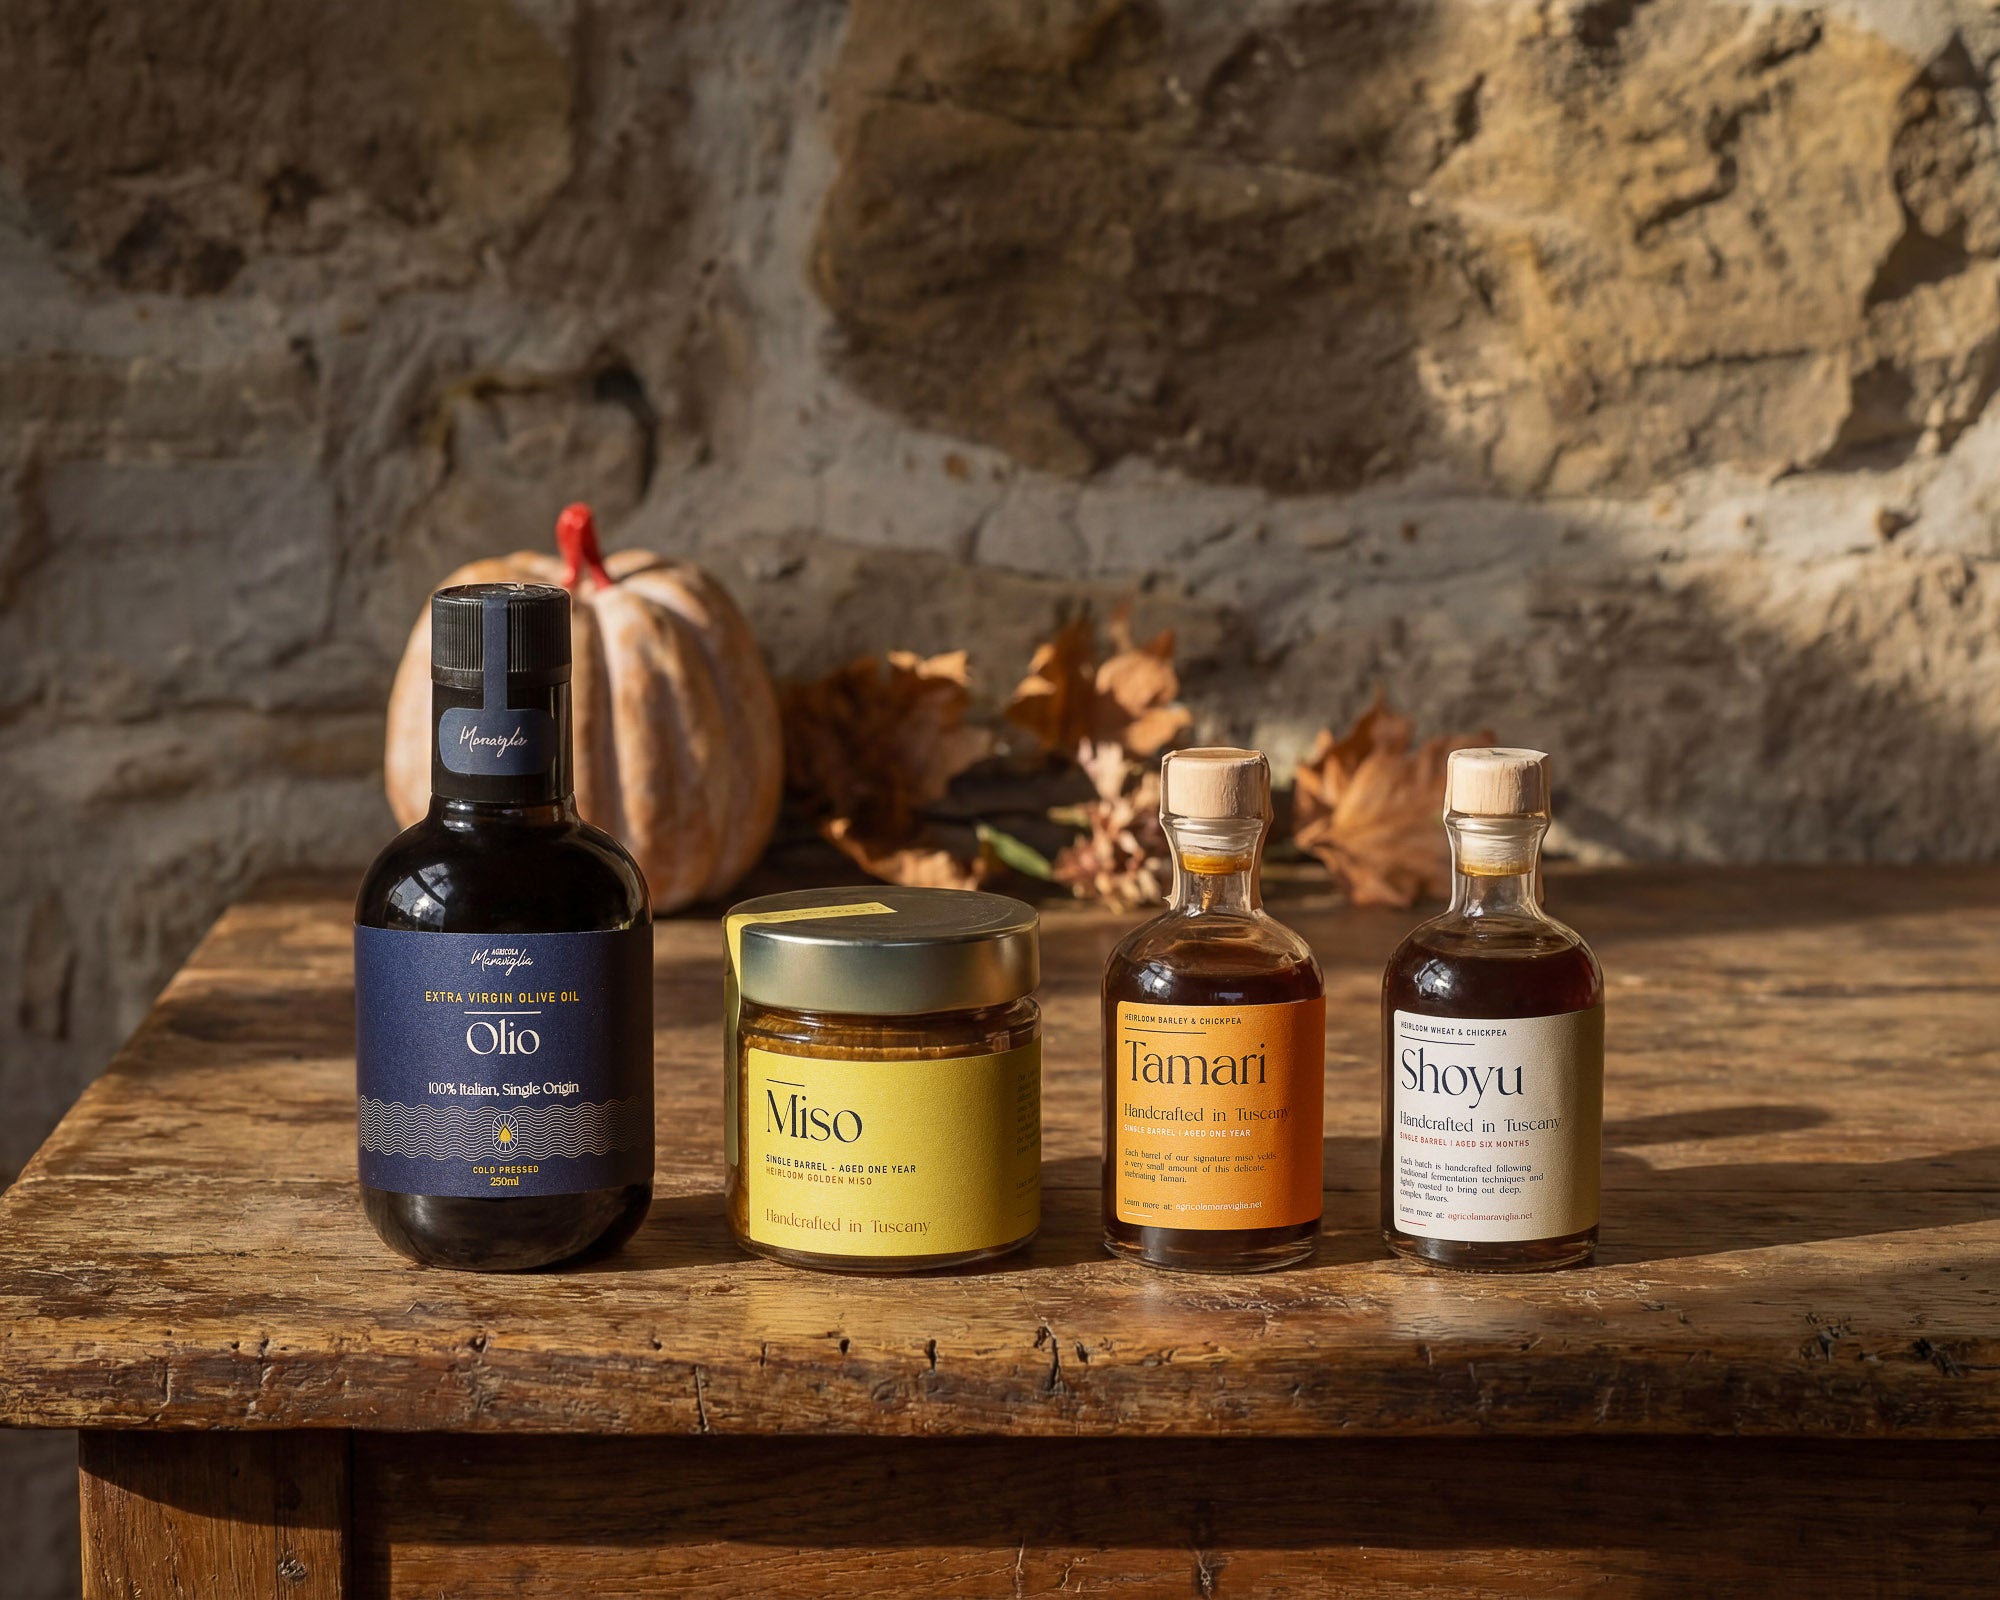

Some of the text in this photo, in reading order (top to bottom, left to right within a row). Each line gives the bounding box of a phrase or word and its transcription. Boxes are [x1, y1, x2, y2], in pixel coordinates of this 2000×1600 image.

[471, 949, 534, 976] Maraviglia
[426, 990, 580, 1003] EXTRA VIRGIN OLIVE OIL
[1124, 1013, 1155, 1023] HEIRLOOM
[1158, 1016, 1188, 1025] BARLEY
[1199, 1017, 1242, 1025] CHICKPEA
[466, 1018, 540, 1055] Olio
[1401, 1021, 1428, 1033] HEIRLOOM
[1431, 1026, 1455, 1036] WHEAT
[1466, 1029, 1507, 1037] CHICKPEA
[1124, 1039, 1266, 1086] Tamari
[1401, 1047, 1524, 1109] Shoyu
[428, 1081, 579, 1098] 100% Italian, Single Origin
[766, 1089, 863, 1143] Miso
[1124, 1103, 1290, 1123] Handcrafted in Tuscany
[1400, 1110, 1561, 1133] Handcrafted in Tuscany
[1124, 1124, 1145, 1134] SINGLE
[1147, 1127, 1175, 1137] BARREL
[1184, 1129, 1207, 1137] AGED
[1210, 1130, 1227, 1138] ONE
[1229, 1129, 1251, 1137] YEAR
[1399, 1131, 1418, 1143] SINGLE
[1420, 1136, 1447, 1146] BARREL
[1455, 1139, 1476, 1147] AGED
[1479, 1140, 1493, 1148] SIX
[1496, 1139, 1530, 1147] MONTHS
[766, 1154, 791, 1166] SINGLE
[794, 1158, 827, 1171] BARREL
[839, 1162, 864, 1174] AGED
[868, 1164, 888, 1174] ONE
[892, 1164, 916, 1173] YEAR
[1125, 1148, 1138, 1157] Each
[1141, 1150, 1160, 1160] barrel
[1164, 1152, 1173, 1161] of
[1194, 1154, 1230, 1163] signature
[1234, 1153, 1254, 1161] miso
[472, 1166, 539, 1174] COLD PRESSED
[1130, 1161, 1144, 1170] very
[1147, 1161, 1164, 1171] small
[1168, 1164, 1198, 1172] amount
[1202, 1163, 1210, 1172] of
[1215, 1164, 1230, 1172] this
[1400, 1156, 1532, 1173] Each batch is handcrafted following
[490, 1176, 519, 1186] 250ml
[766, 1167, 872, 1186] HEIRLOOM GOLDEN MISO
[1159, 1173, 1187, 1183] Tamari.
[1400, 1168, 1543, 1184] traditional fermentation techniques and
[1400, 1189, 1449, 1203] complex flavors.
[1417, 1181, 1442, 1192] roasted
[1445, 1185, 1454, 1193] to
[1457, 1184, 1478, 1195] bring
[1482, 1186, 1495, 1194] out
[1124, 1197, 1263, 1212] Learn more at: agricolamaraviglia.net
[766, 1208, 932, 1235] Handcrafted in Tuscany
[1399, 1204, 1533, 1223] Learn more at: agricolamaraviglia.net
